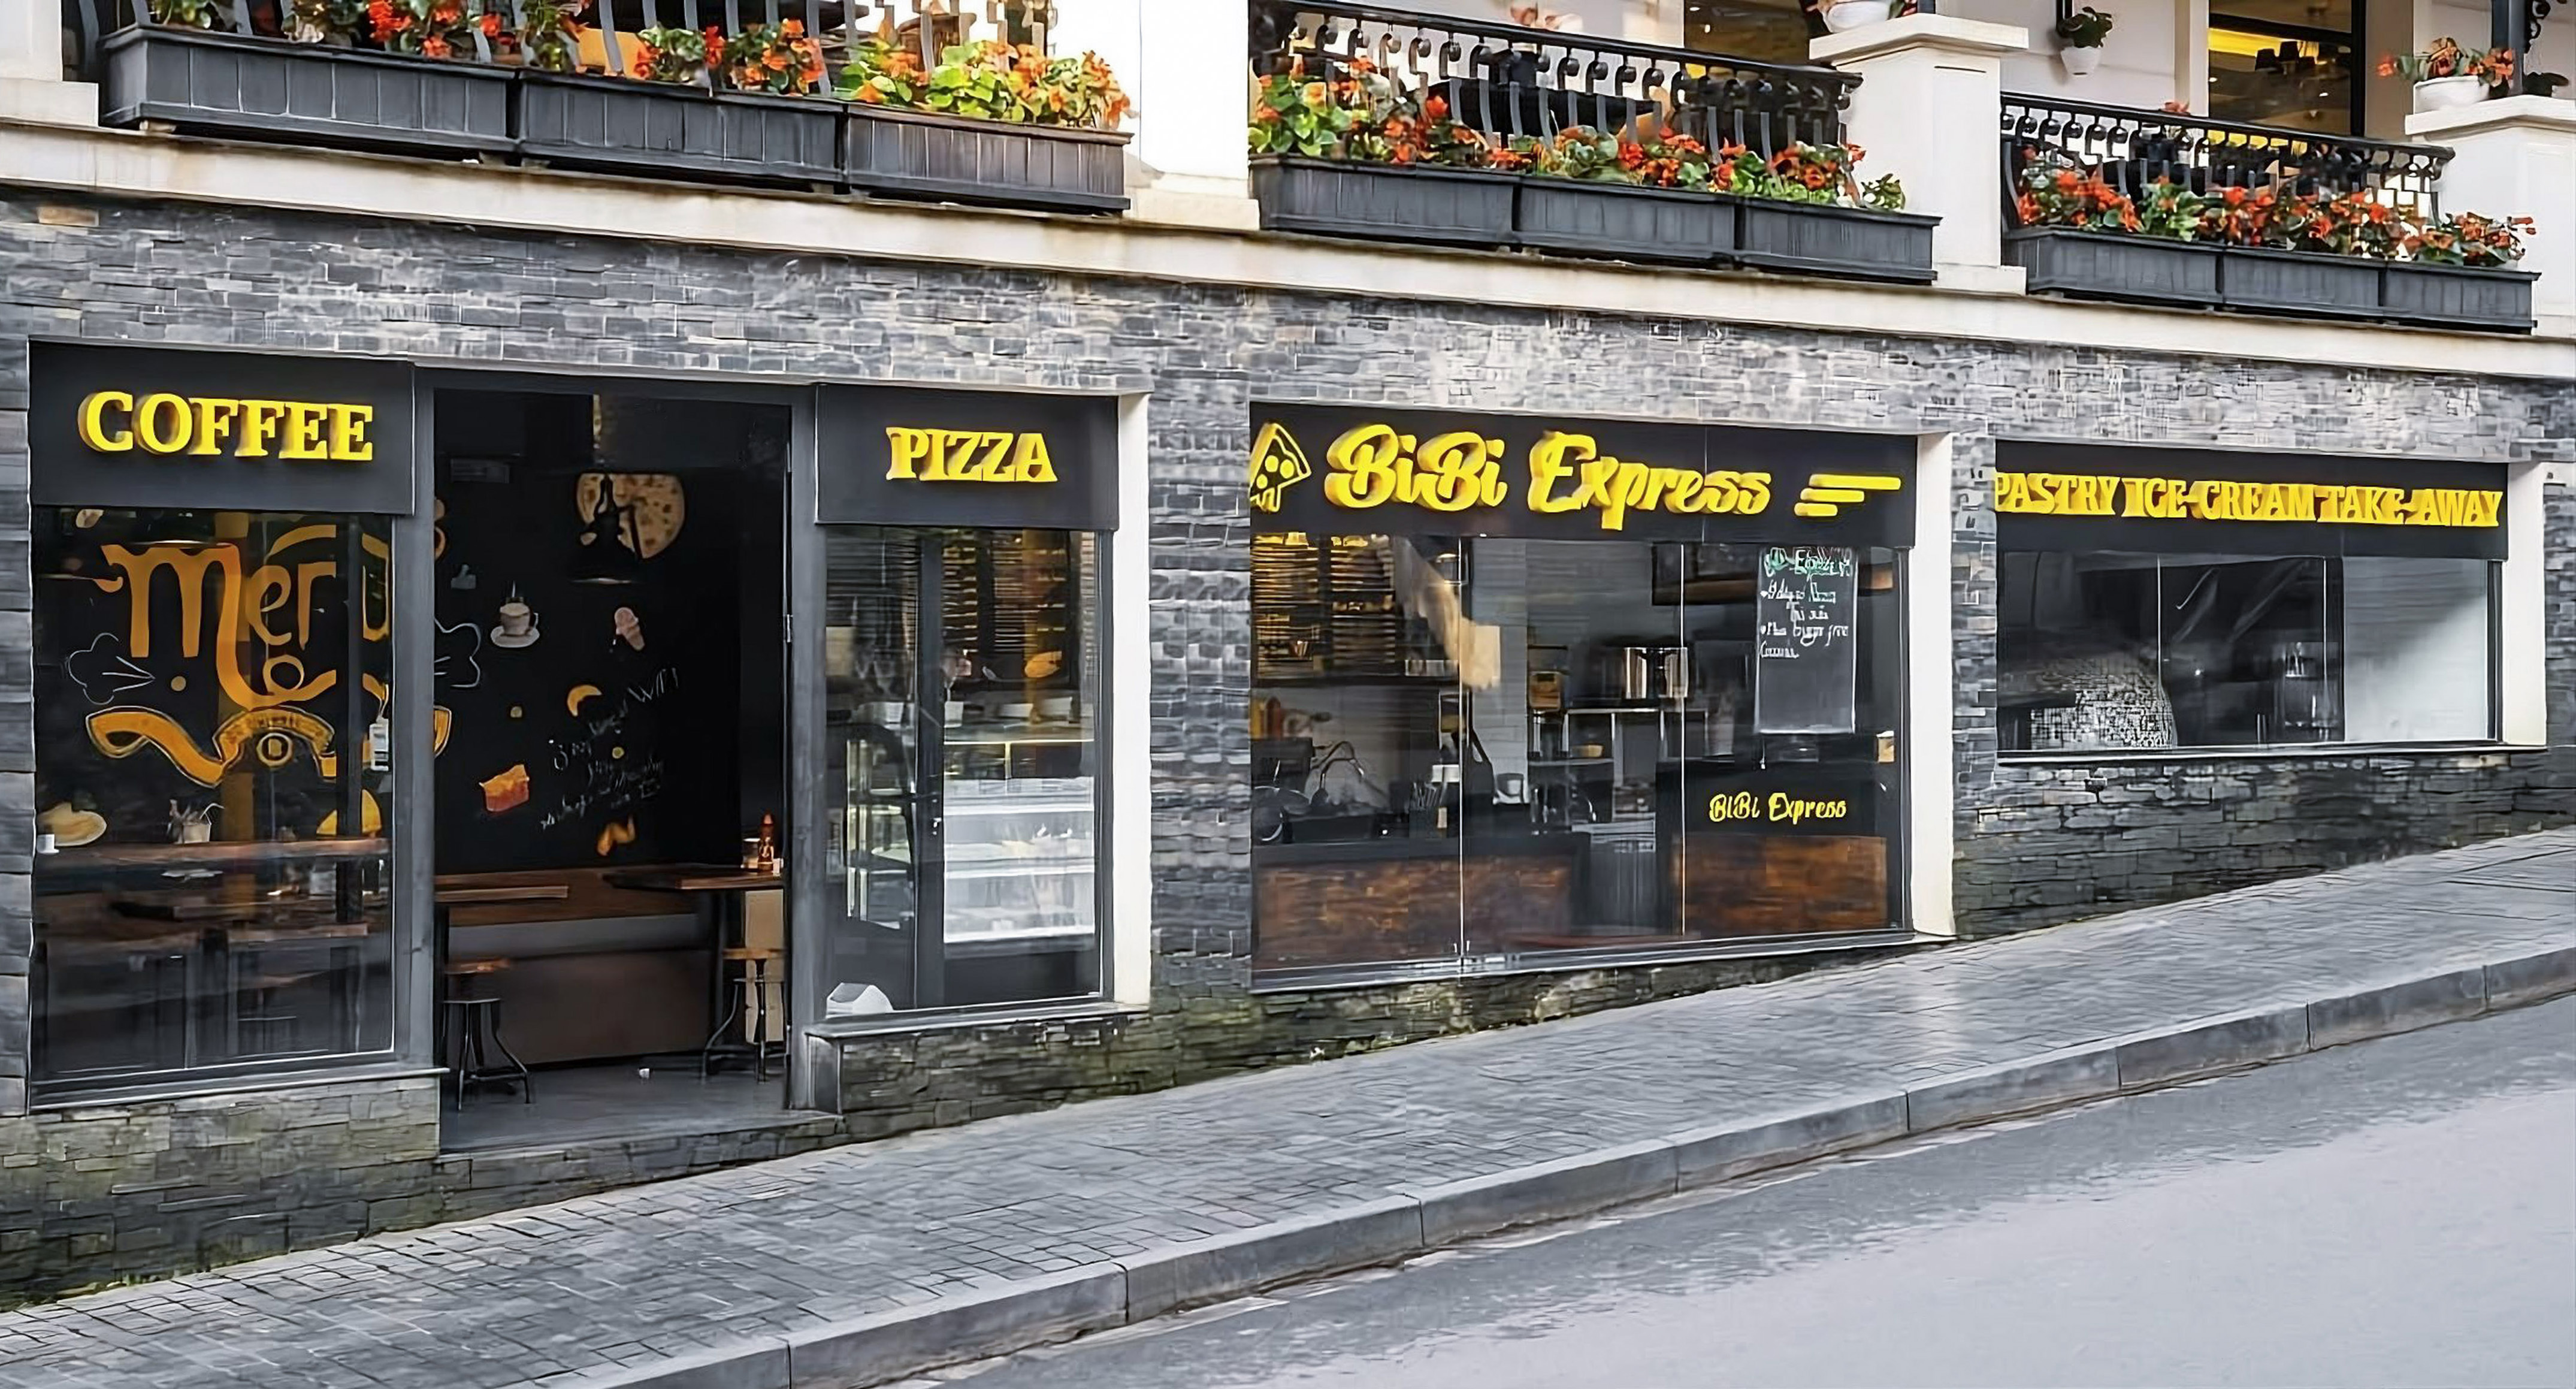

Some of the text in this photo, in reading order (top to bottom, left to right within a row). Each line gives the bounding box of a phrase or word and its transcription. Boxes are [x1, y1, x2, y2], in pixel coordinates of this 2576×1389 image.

[77, 391, 373, 461] COFFEE
[885, 426, 1058, 484] PIZZA
[1324, 424, 1773, 531] BiBi Express
[1994, 472, 2504, 528] PASTRY ICE-CREAM TAKE-AWAY
[1768, 792, 1847, 825] Express
